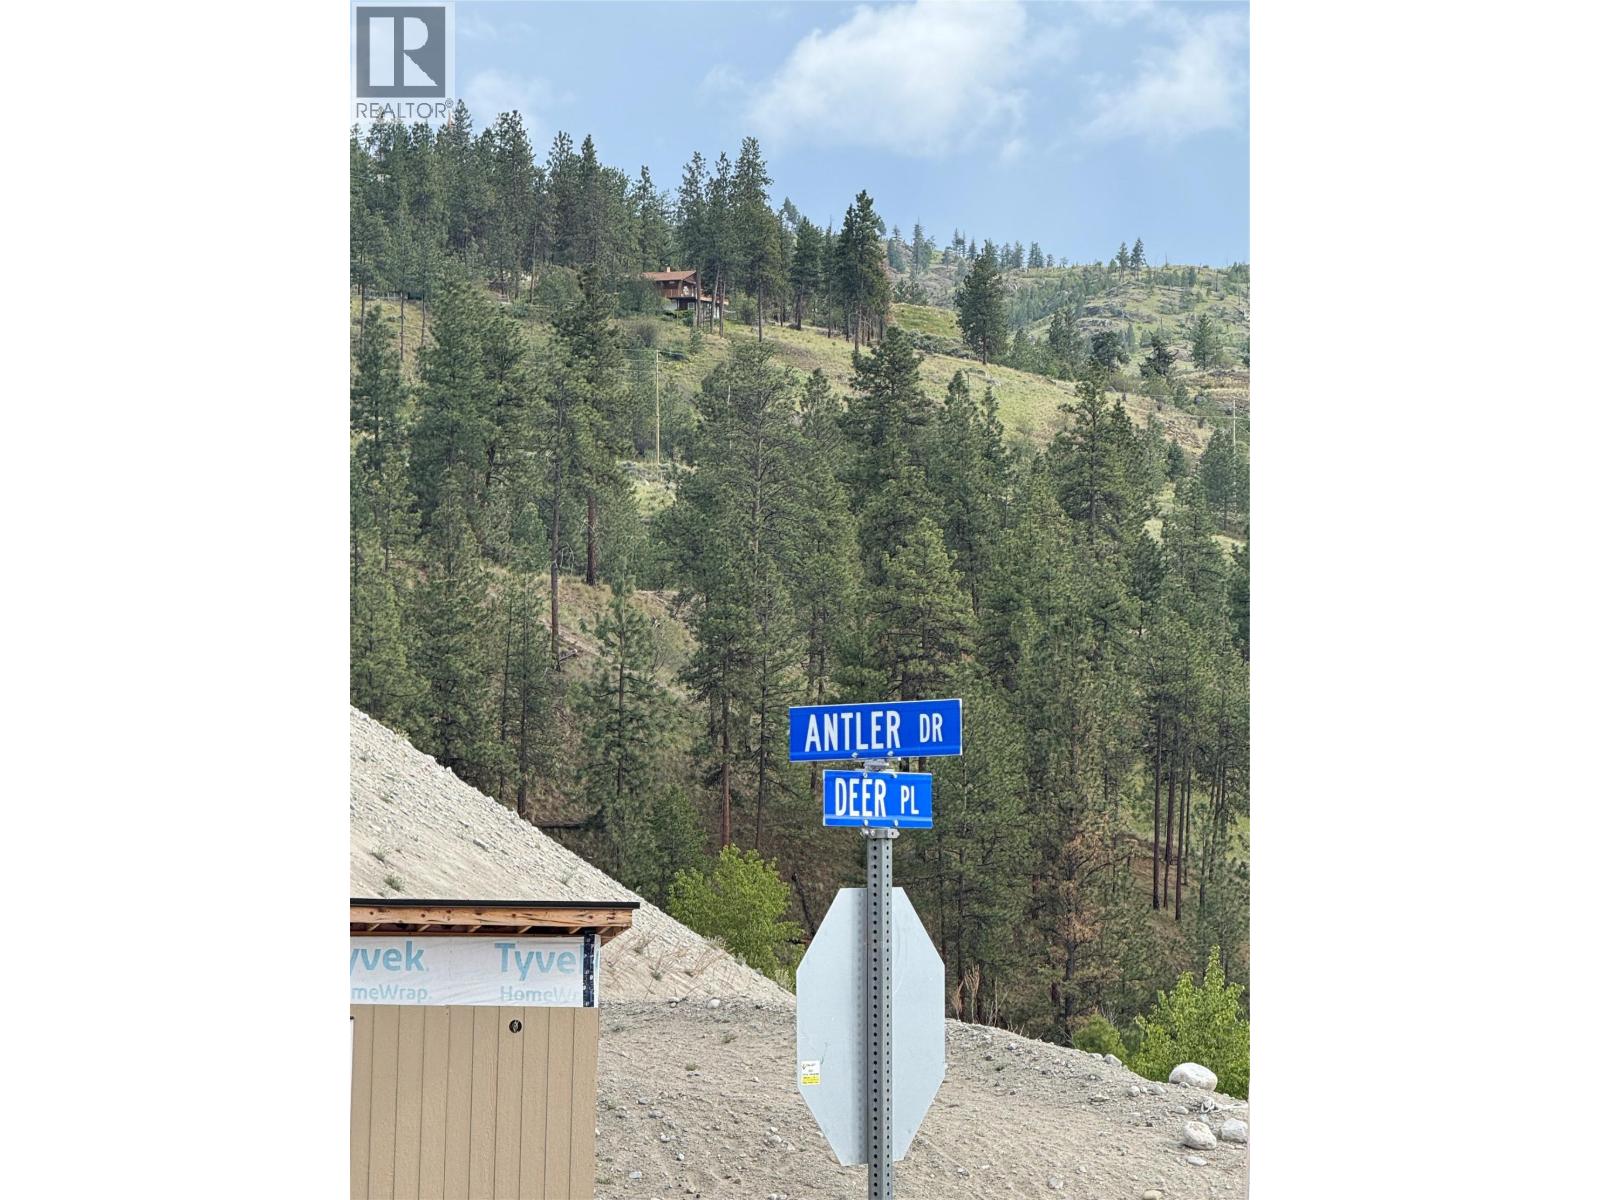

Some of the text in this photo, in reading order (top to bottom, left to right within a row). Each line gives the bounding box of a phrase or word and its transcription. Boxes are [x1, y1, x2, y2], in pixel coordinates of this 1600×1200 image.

[804, 710, 943, 752] ANTLER DR
[835, 777, 919, 817] DEER PL
